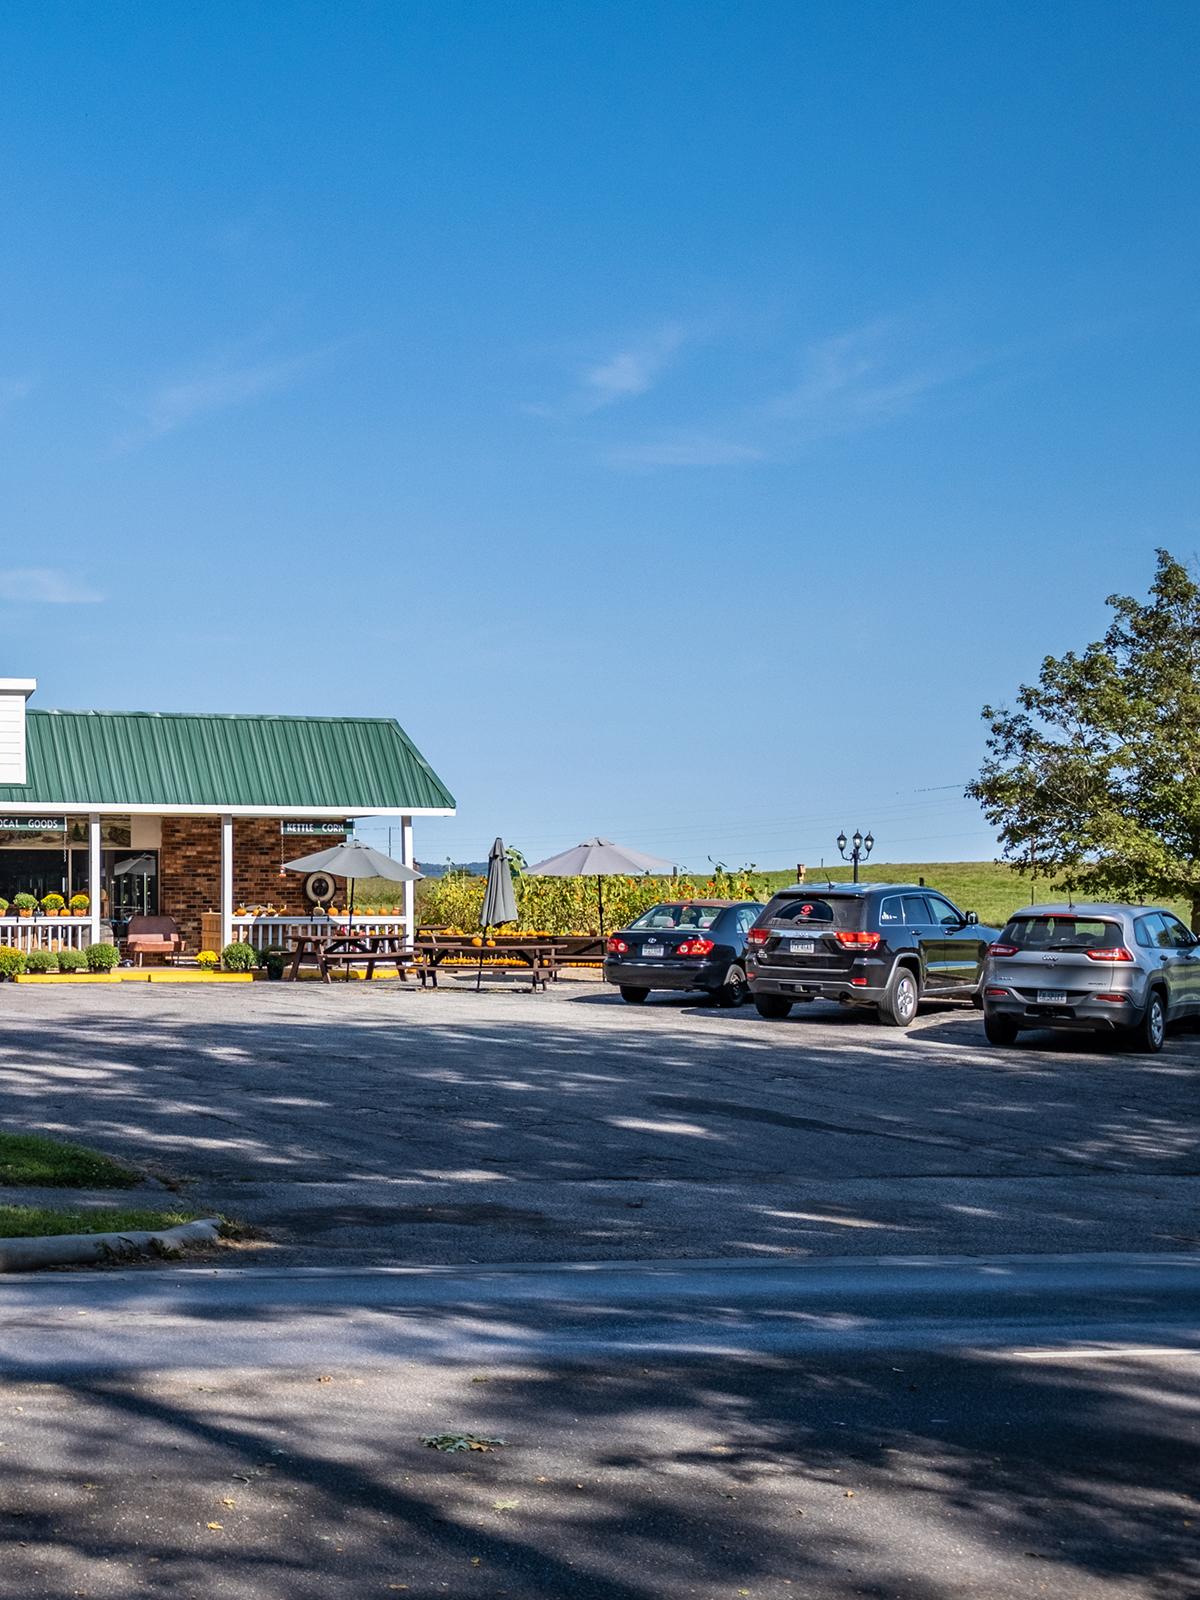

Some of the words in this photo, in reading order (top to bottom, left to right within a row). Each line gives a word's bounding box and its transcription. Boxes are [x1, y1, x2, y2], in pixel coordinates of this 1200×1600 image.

[27, 819, 58, 829] GOODS
[287, 823, 314, 832] KETTLE
[321, 823, 344, 832] CORN
